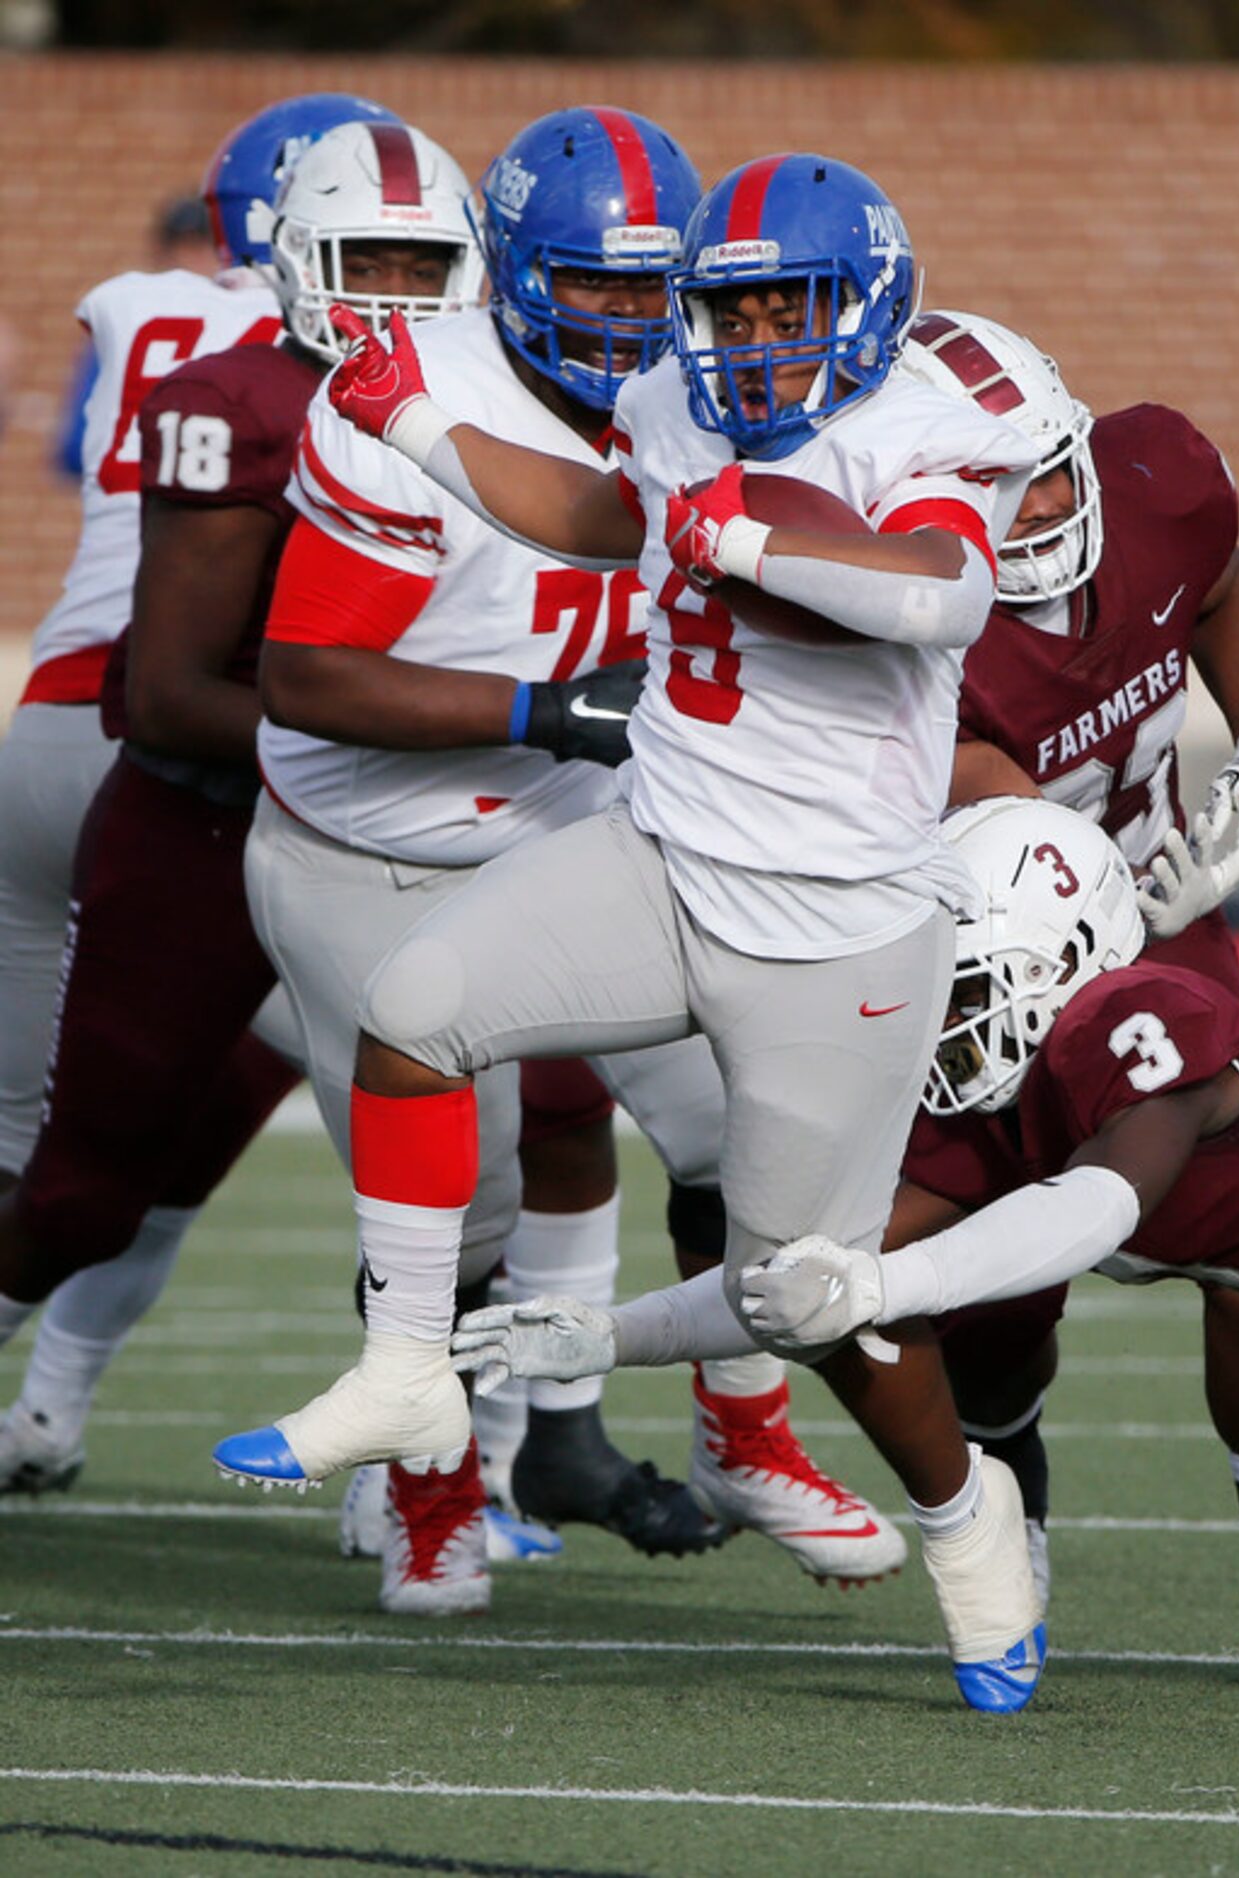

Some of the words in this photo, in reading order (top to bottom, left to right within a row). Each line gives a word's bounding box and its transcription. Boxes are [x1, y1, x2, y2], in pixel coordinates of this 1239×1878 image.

[718, 243, 763, 258] Riddell
[97, 316, 284, 496] 6
[157, 411, 232, 493] 18
[1037, 648, 1181, 776] FARMERS
[1033, 842, 1080, 899] 3
[1107, 1011, 1185, 1093] 3
